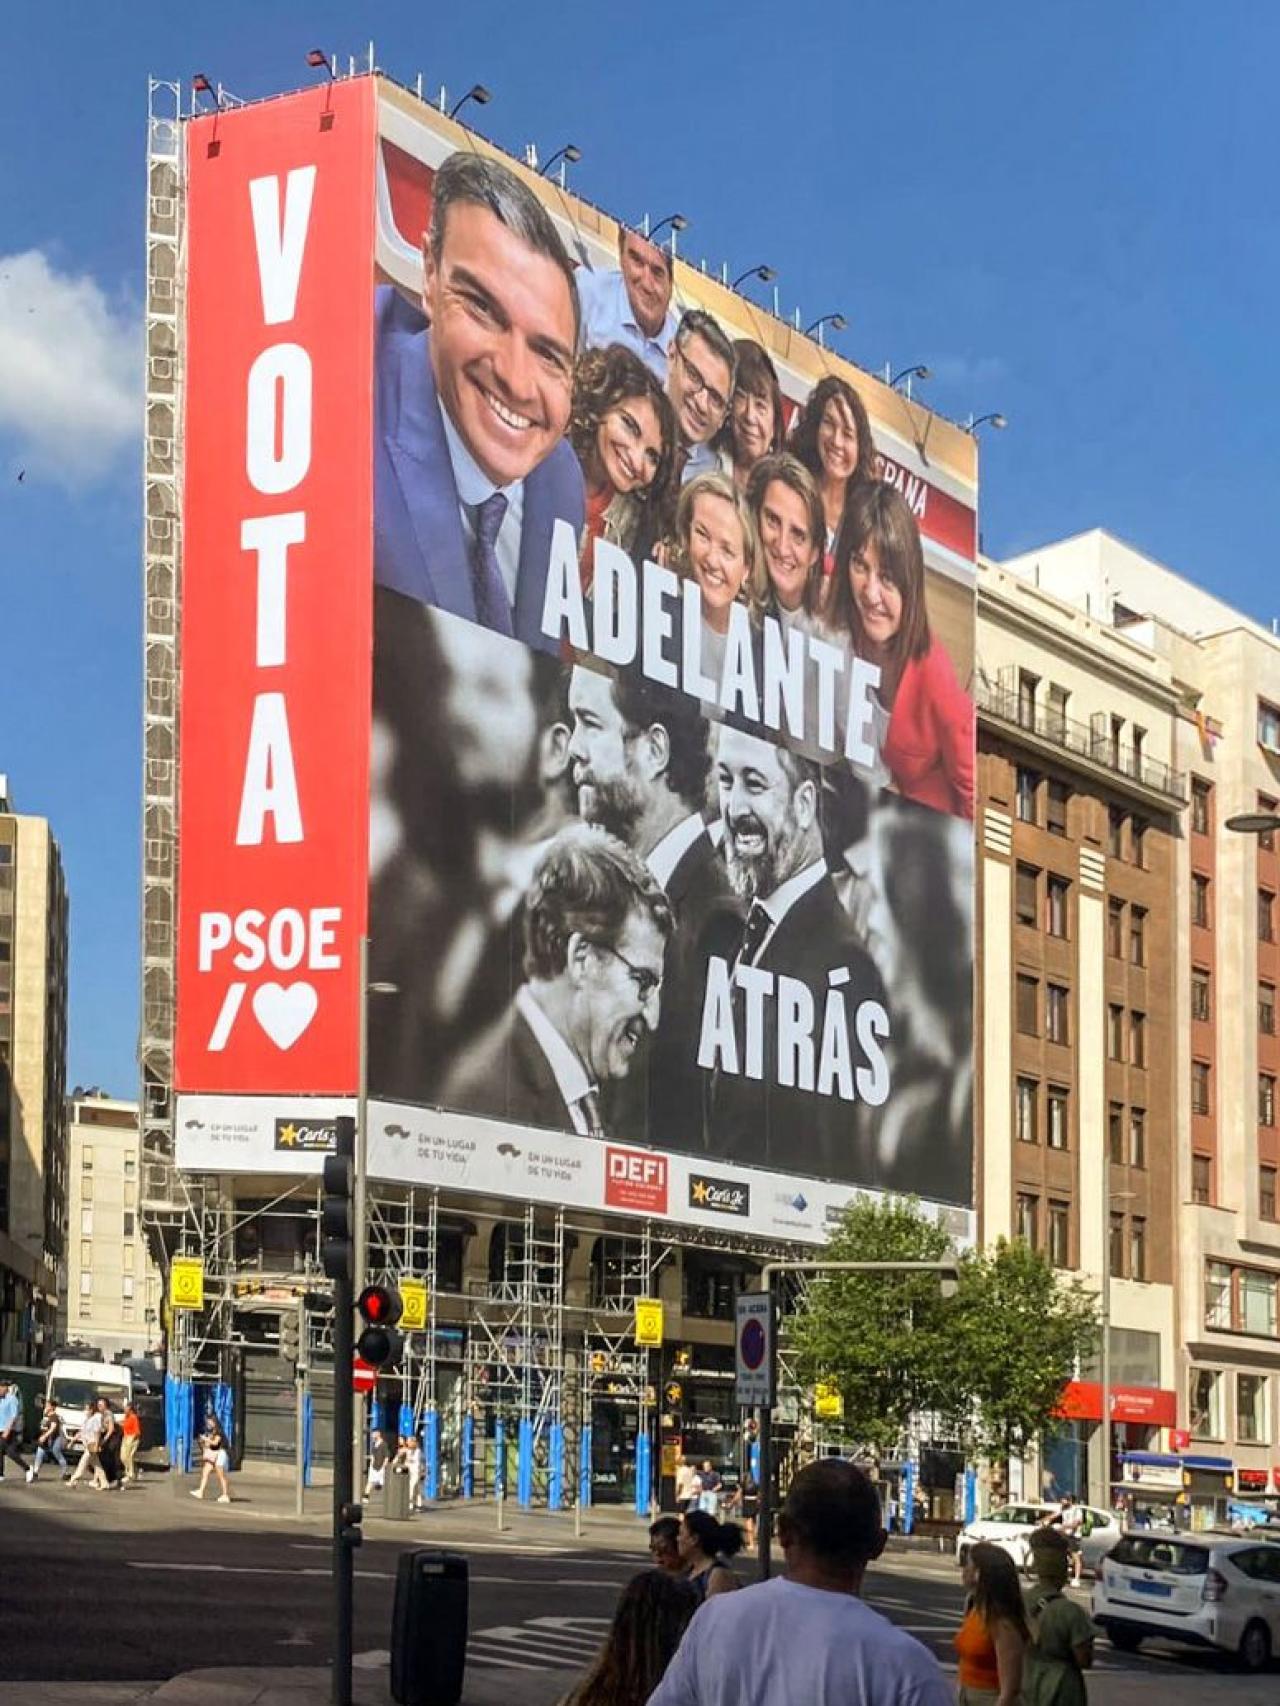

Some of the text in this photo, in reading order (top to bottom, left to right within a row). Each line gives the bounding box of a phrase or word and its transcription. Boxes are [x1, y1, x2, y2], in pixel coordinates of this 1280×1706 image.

[235, 165, 317, 845] VOTA
[541, 518, 881, 767] ADELANTE
[198, 907, 342, 972] PSOE
[697, 956, 890, 1106] ATRÁS
[447, 1138, 477, 1151] LUGAR
[610, 1154, 665, 1186] DEFI
